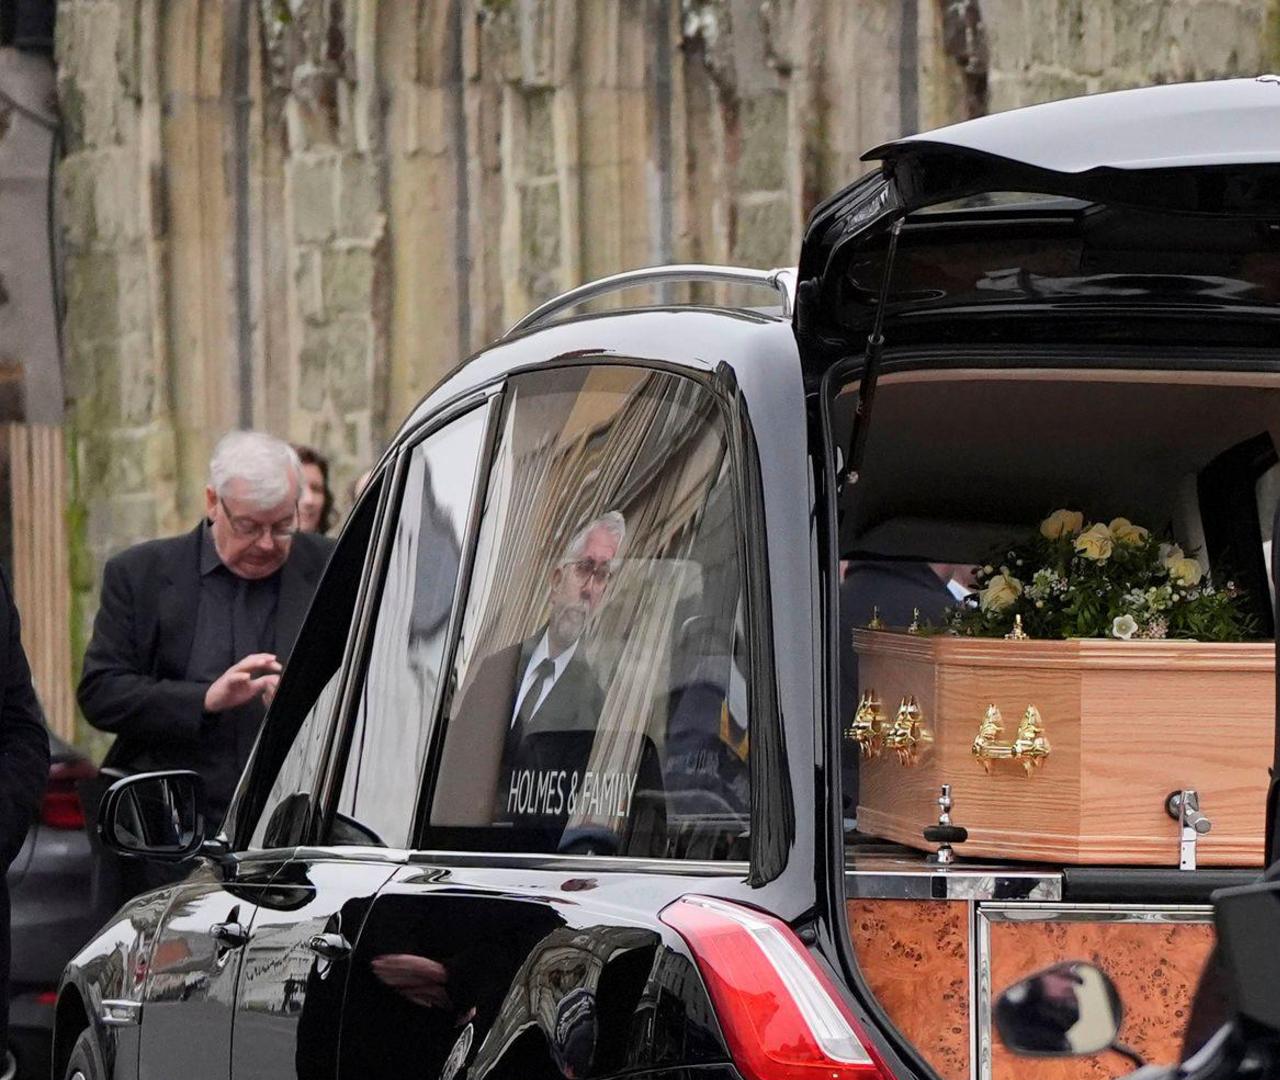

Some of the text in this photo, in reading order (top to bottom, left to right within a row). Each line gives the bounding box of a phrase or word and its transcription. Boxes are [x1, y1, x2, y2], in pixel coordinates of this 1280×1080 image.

[507, 769, 638, 818] HOLMES & FAMILY
